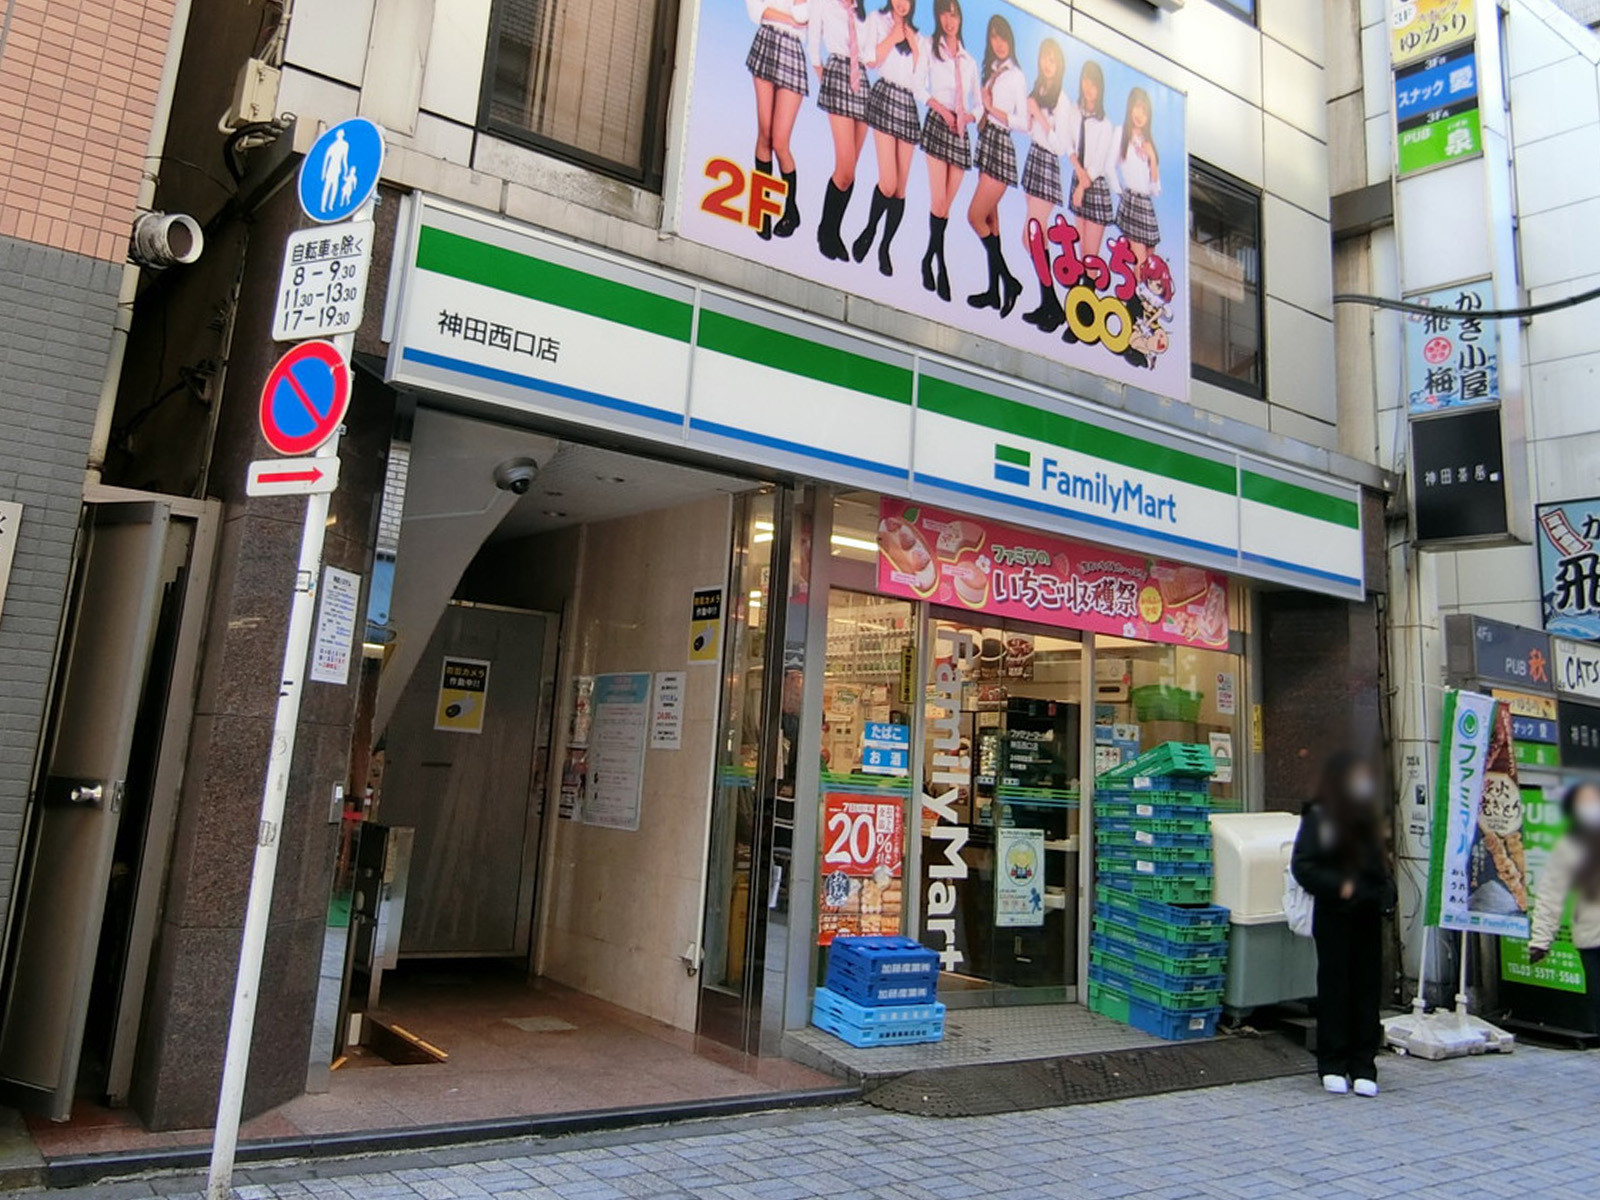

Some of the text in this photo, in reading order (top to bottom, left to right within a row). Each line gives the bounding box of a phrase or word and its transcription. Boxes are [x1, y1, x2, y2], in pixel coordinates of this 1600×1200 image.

[1400, 13, 1467, 52] ゆかり
[1398, 79, 1444, 109] スナック
[699, 156, 789, 233] 2F
[291, 234, 364, 263] 自転車を除く
[437, 309, 561, 364] 神田西口店
[1455, 291, 1488, 401] かき小屋
[1041, 456, 1177, 524] FamilyMart
[991, 545, 1051, 566] ファミマの
[992, 567, 1139, 618] いちご収穫祭
[1505, 657, 1528, 677] PUB
[871, 724, 902, 741] たばこ
[920, 628, 973, 972] FamilyMart
[825, 812, 875, 864] 20
